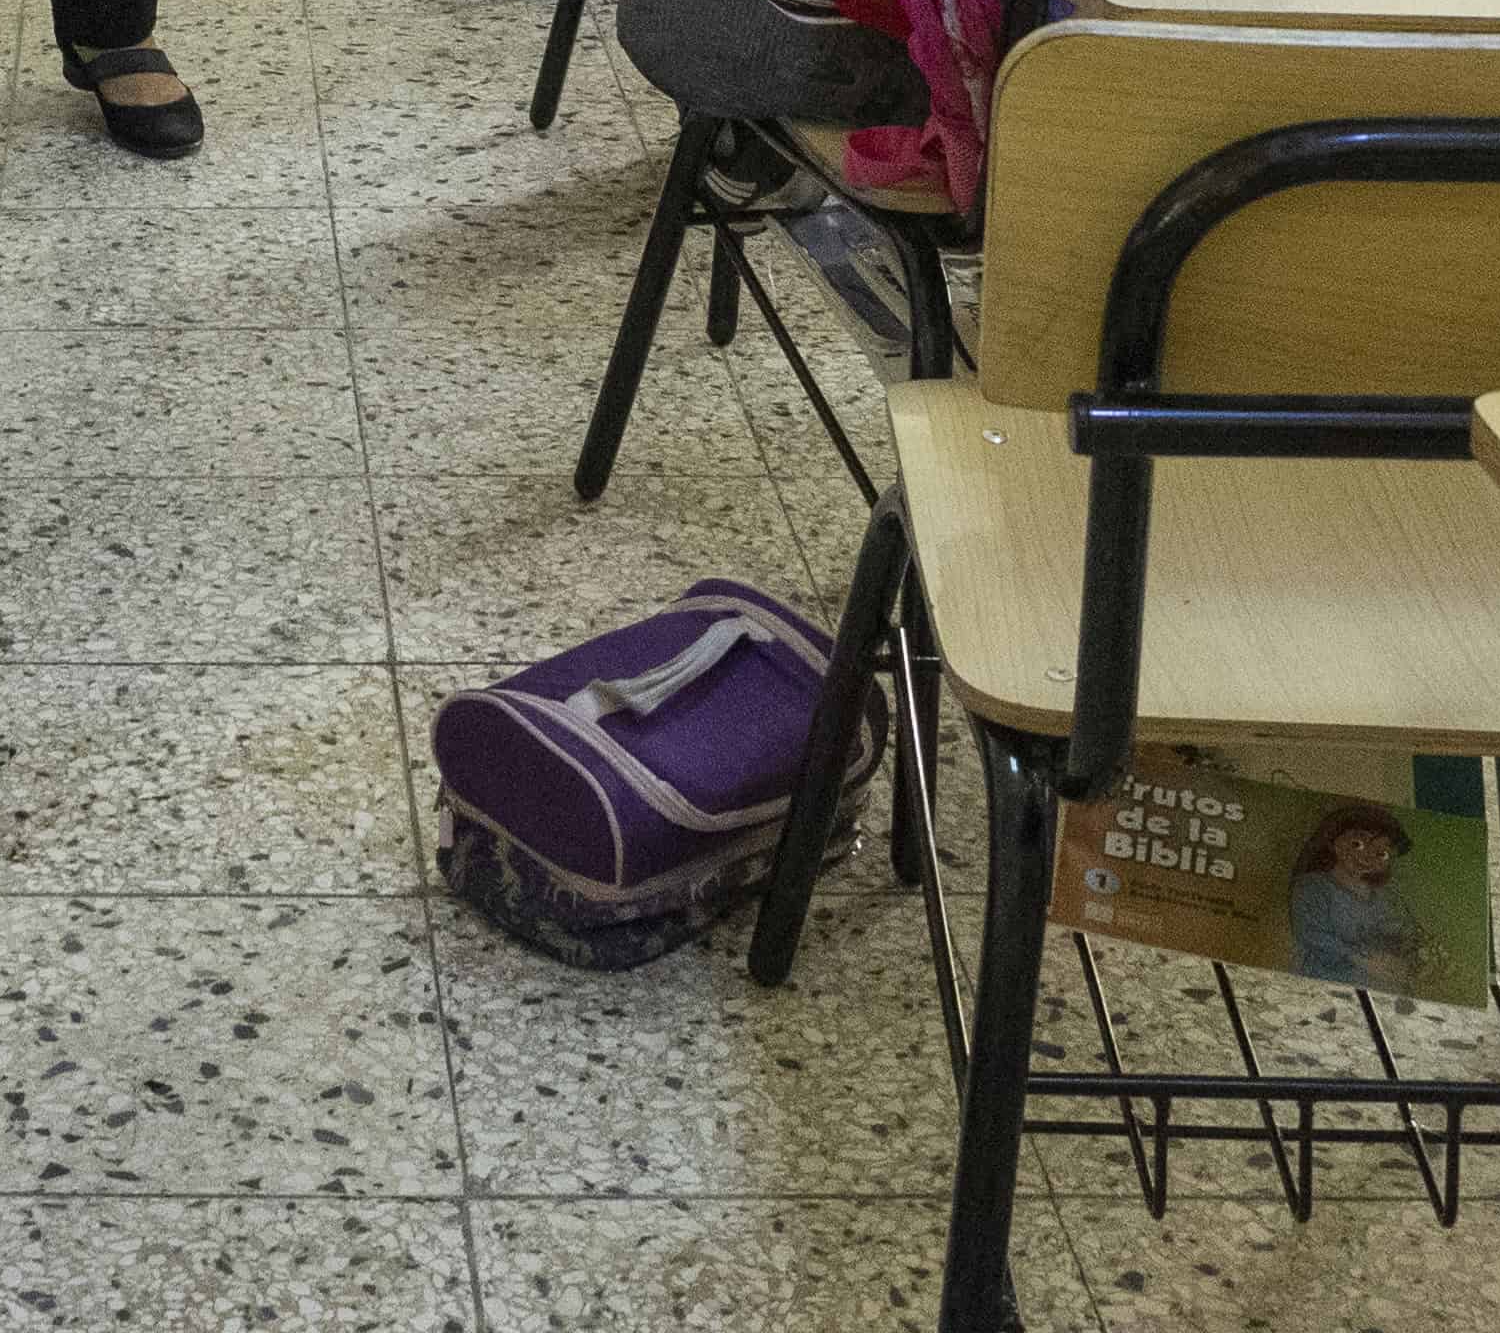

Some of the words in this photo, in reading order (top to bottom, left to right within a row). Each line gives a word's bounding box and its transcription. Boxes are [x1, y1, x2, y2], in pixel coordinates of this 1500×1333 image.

[1122, 774, 1245, 822] rutos
[1115, 806, 1171, 836] de
[1188, 817, 1228, 848] la
[1103, 830, 1236, 880] Biblia
